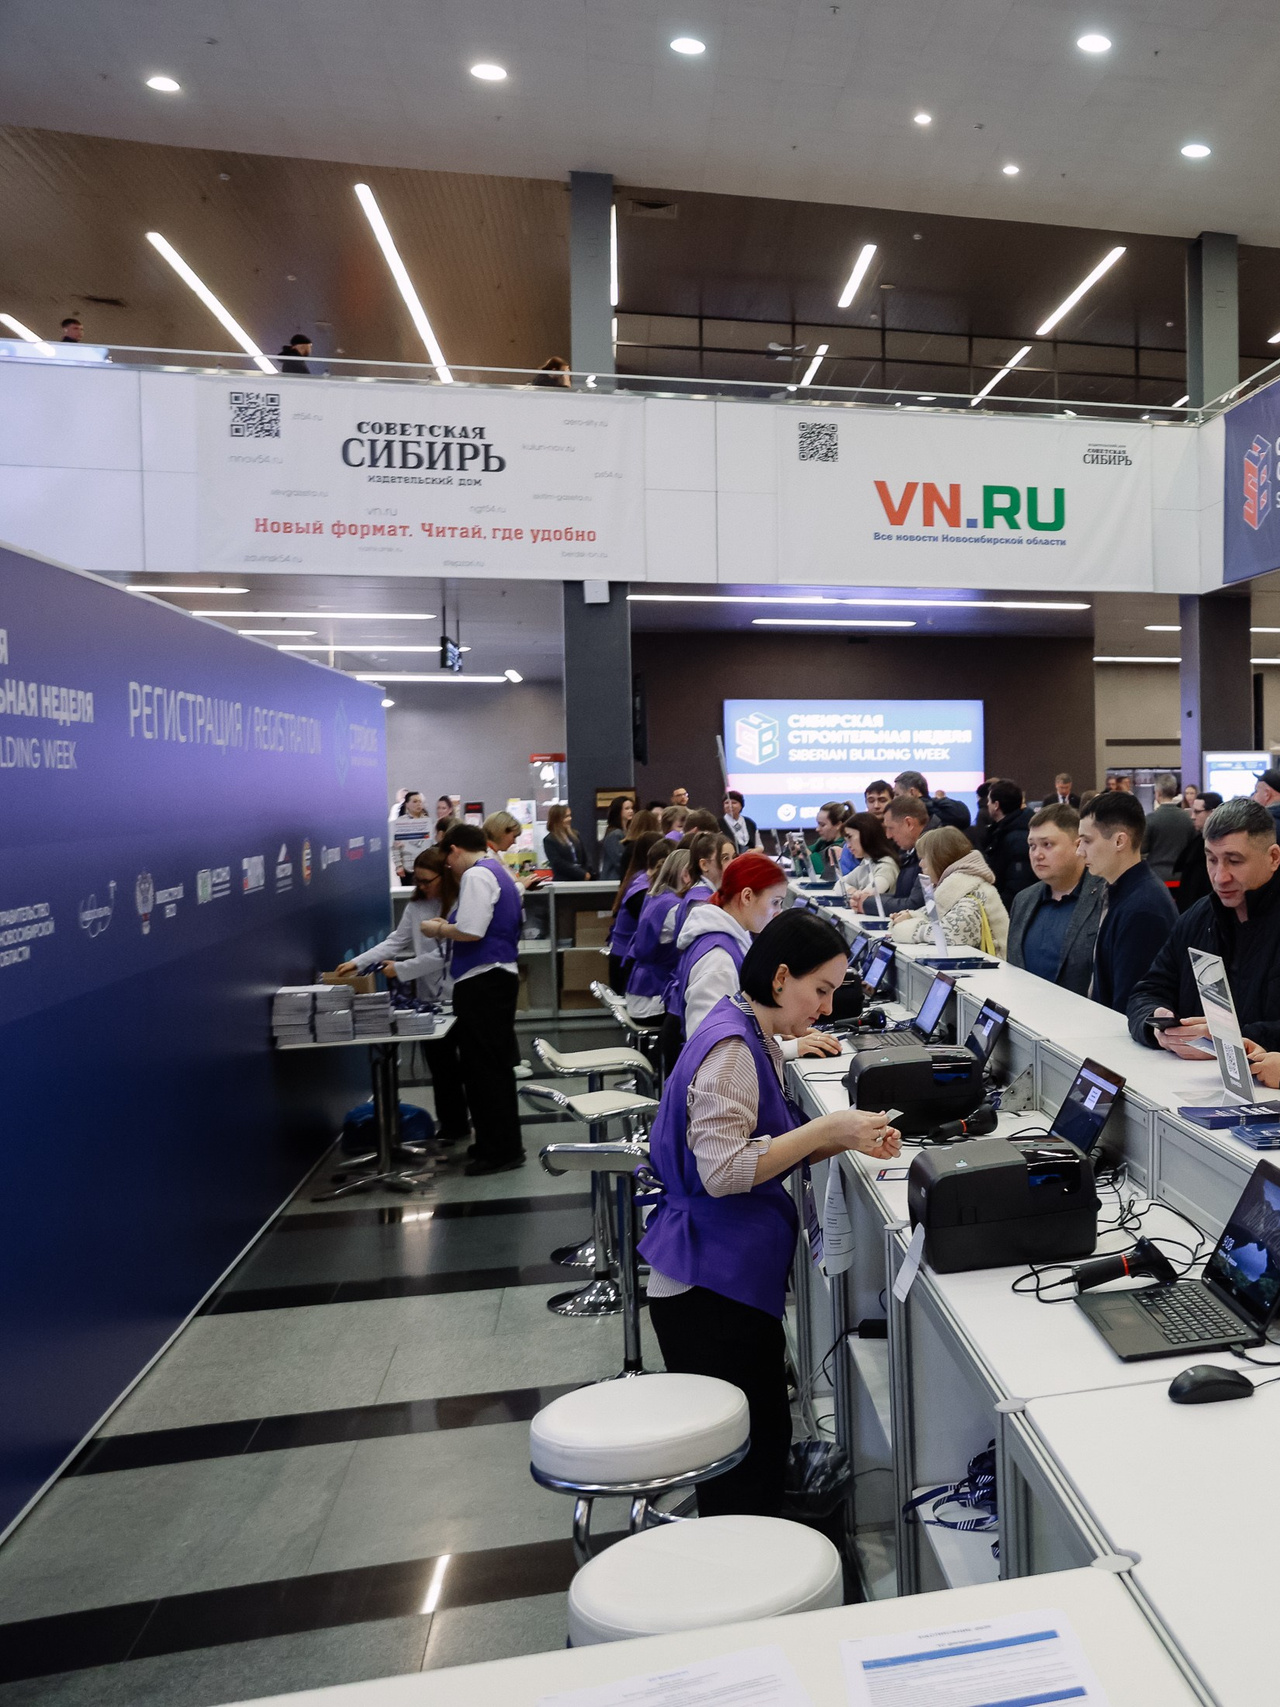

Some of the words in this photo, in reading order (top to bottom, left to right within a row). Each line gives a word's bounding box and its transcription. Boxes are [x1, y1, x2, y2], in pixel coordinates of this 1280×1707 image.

[356, 420, 486, 440] СОВЕТСКАЯ
[341, 437, 507, 473] СИБИРЬ
[1083, 453, 1133, 466] СИБИРЬ
[368, 473, 454, 487] издательский
[458, 477, 483, 488] дом
[873, 480, 1065, 532] VN.RU
[254, 517, 325, 536] Новый
[331, 519, 414, 539] формат.
[420, 522, 489, 542] Читай,
[491, 526, 525, 543] где
[530, 525, 597, 544] удобно
[873, 532, 893, 541] Все
[896, 534, 939, 544] новости
[941, 534, 1024, 546] Новосибирской
[1026, 536, 1066, 546] области
[40, 684, 95, 727] НЕДЕЛЯ
[129, 681, 243, 755] РЕГИСТРАЦИЯ
[787, 714, 884, 728] СИБИРСКАЯ
[43, 740, 78, 769] WEEK
[788, 748, 848, 762] SIBERIAN
[849, 748, 911, 761] BUILDING
[912, 749, 951, 761] WEEK
